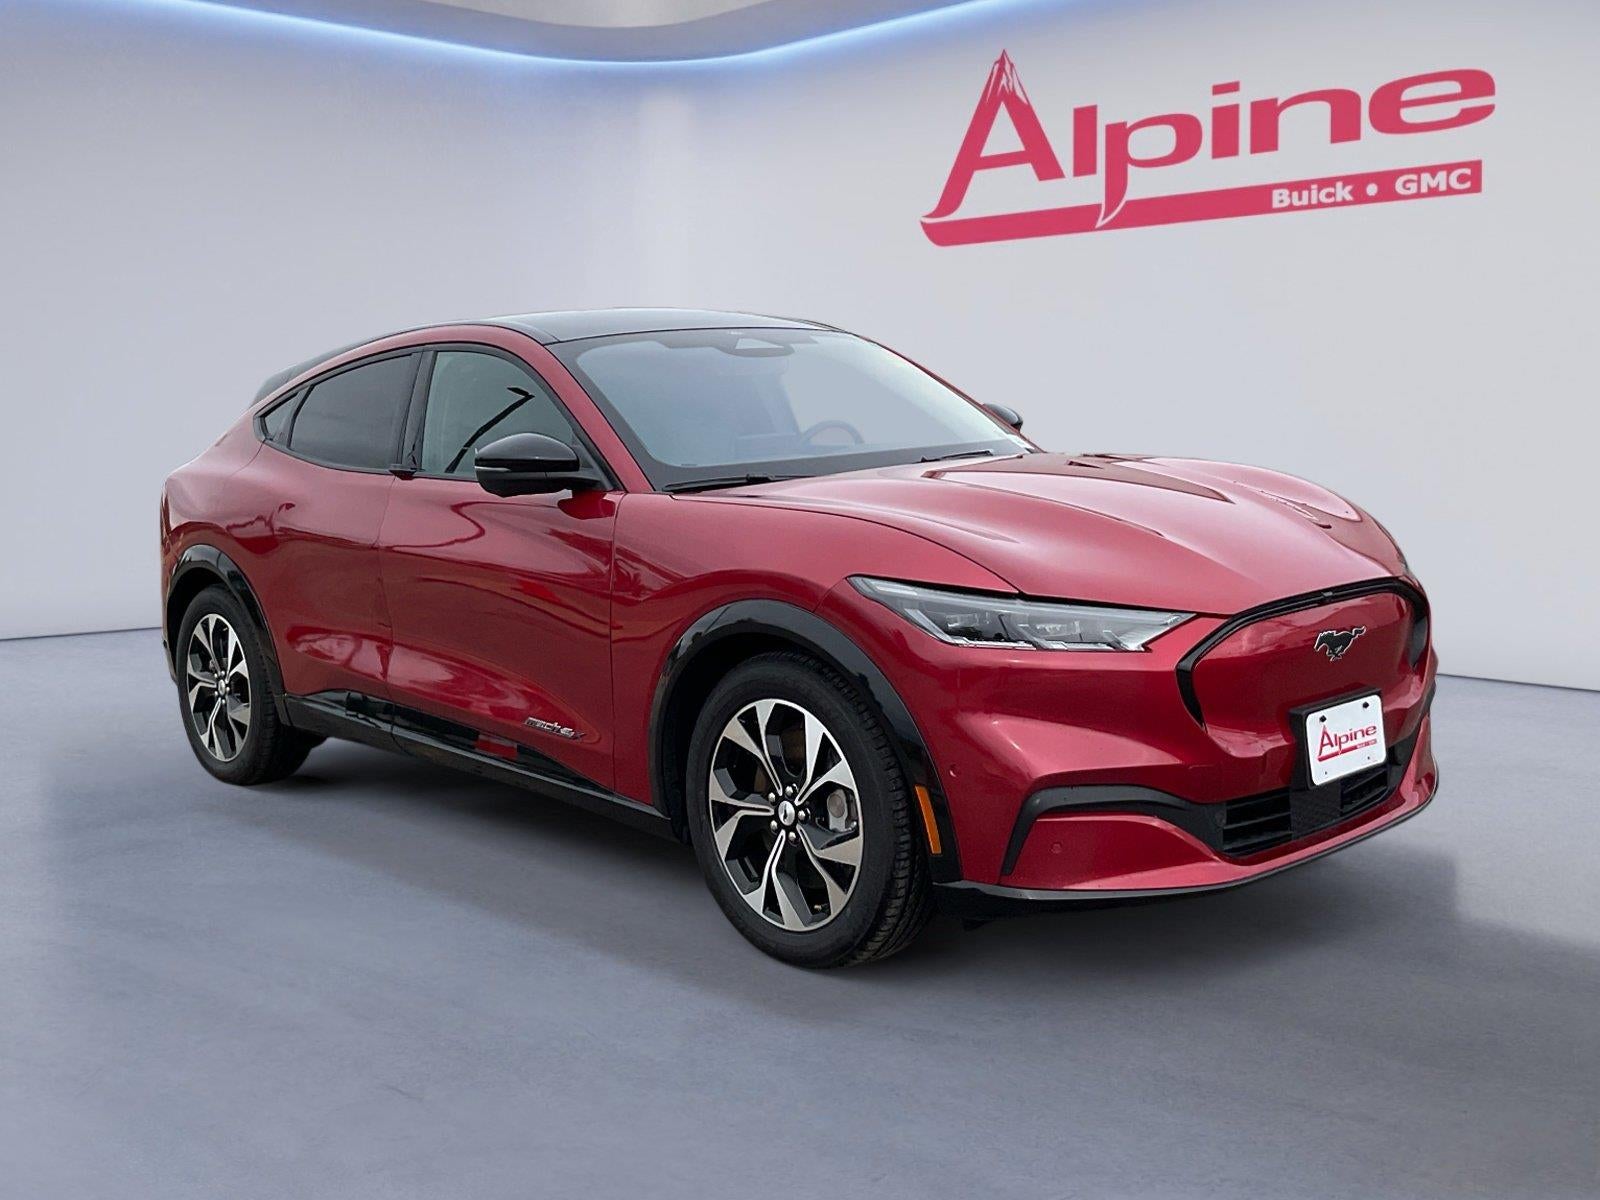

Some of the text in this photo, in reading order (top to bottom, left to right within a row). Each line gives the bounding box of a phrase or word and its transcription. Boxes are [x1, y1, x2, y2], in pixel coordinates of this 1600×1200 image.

[920, 49, 1496, 229] Alpine
[1271, 168, 1472, 209] Buick GMC
[1318, 724, 1377, 756] Alpine
